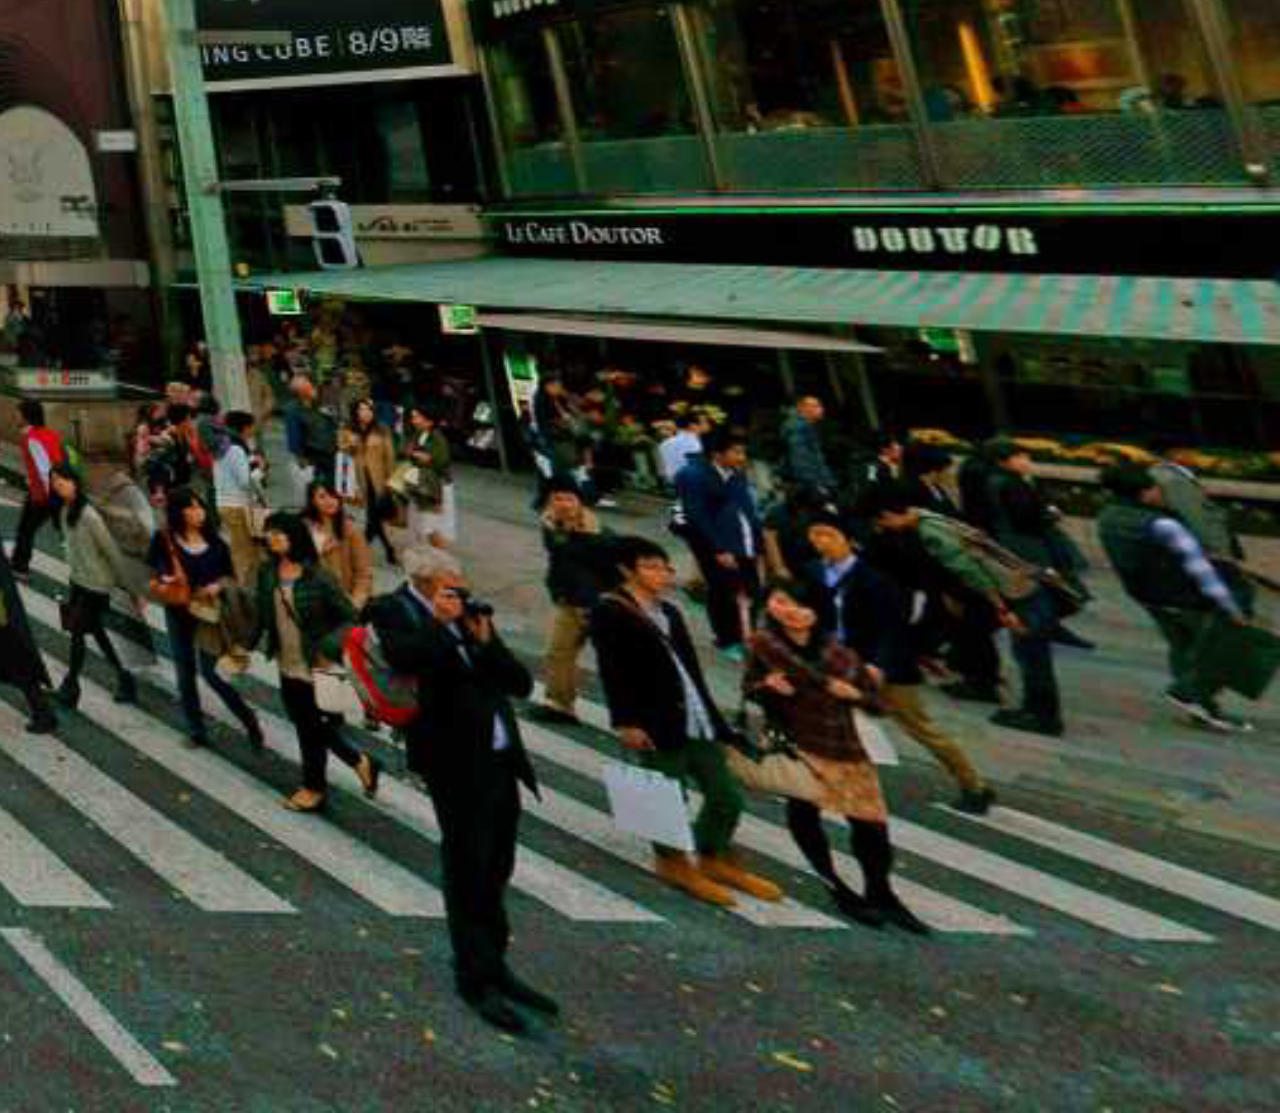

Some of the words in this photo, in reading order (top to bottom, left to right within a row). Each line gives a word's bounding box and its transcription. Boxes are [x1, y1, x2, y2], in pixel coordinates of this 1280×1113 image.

[203, 41, 249, 65] ING
[570, 220, 664, 245] DOUTOR
[852, 223, 1039, 255] DOUTOR
